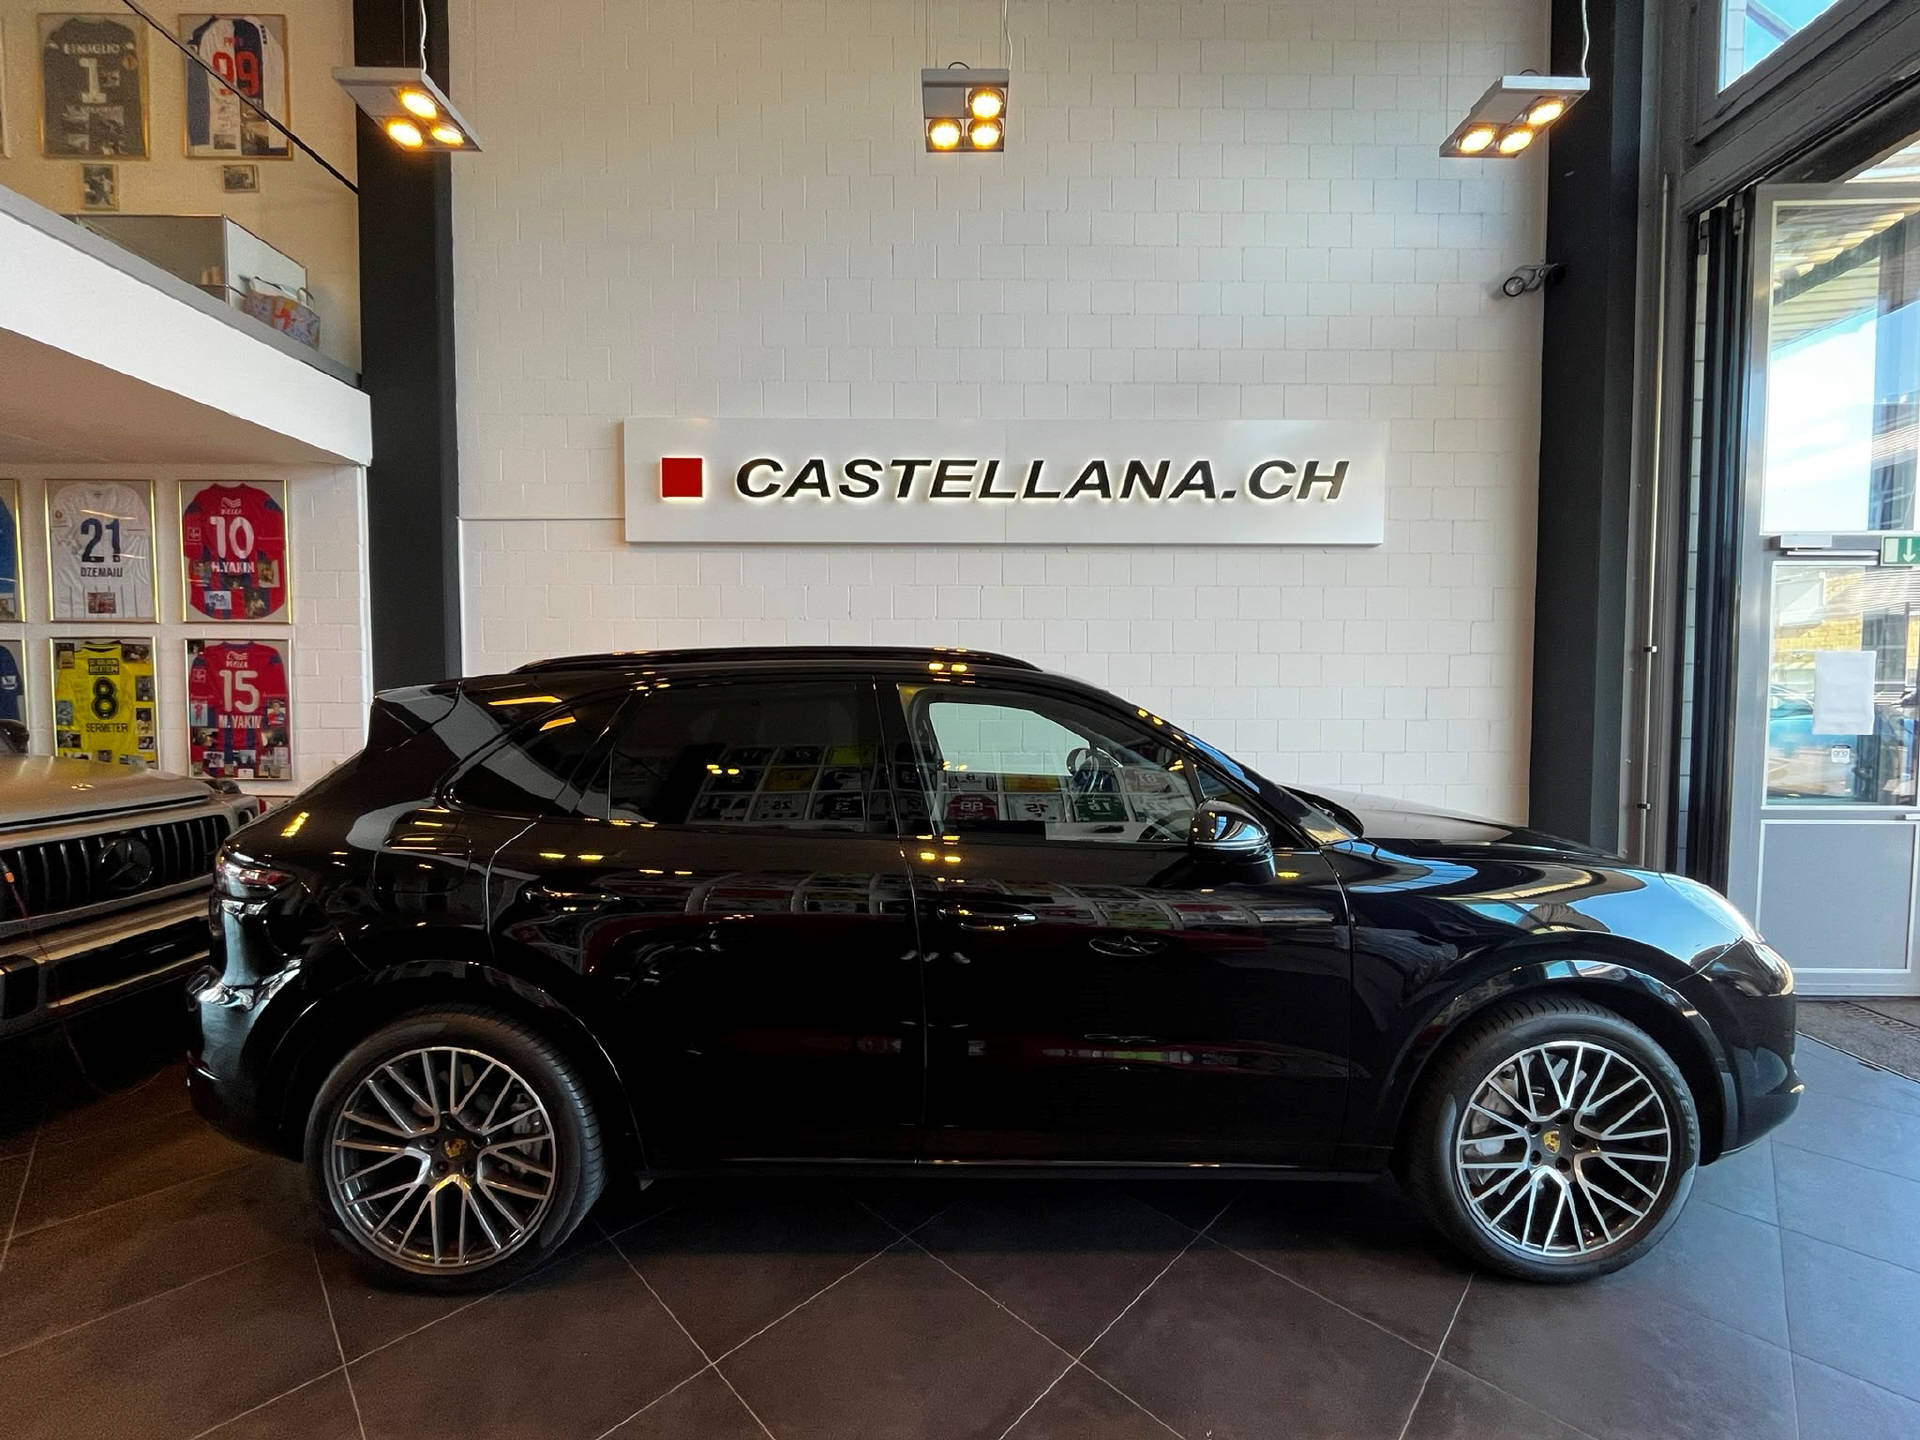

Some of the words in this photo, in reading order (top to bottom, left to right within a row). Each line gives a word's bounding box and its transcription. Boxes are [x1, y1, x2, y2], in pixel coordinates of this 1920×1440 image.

[735, 457, 1350, 500] CASTELLANA.CH
[80, 517, 121, 563] 21
[209, 515, 255, 559] 10
[91, 676, 120, 721] 8
[218, 669, 260, 713] 15
